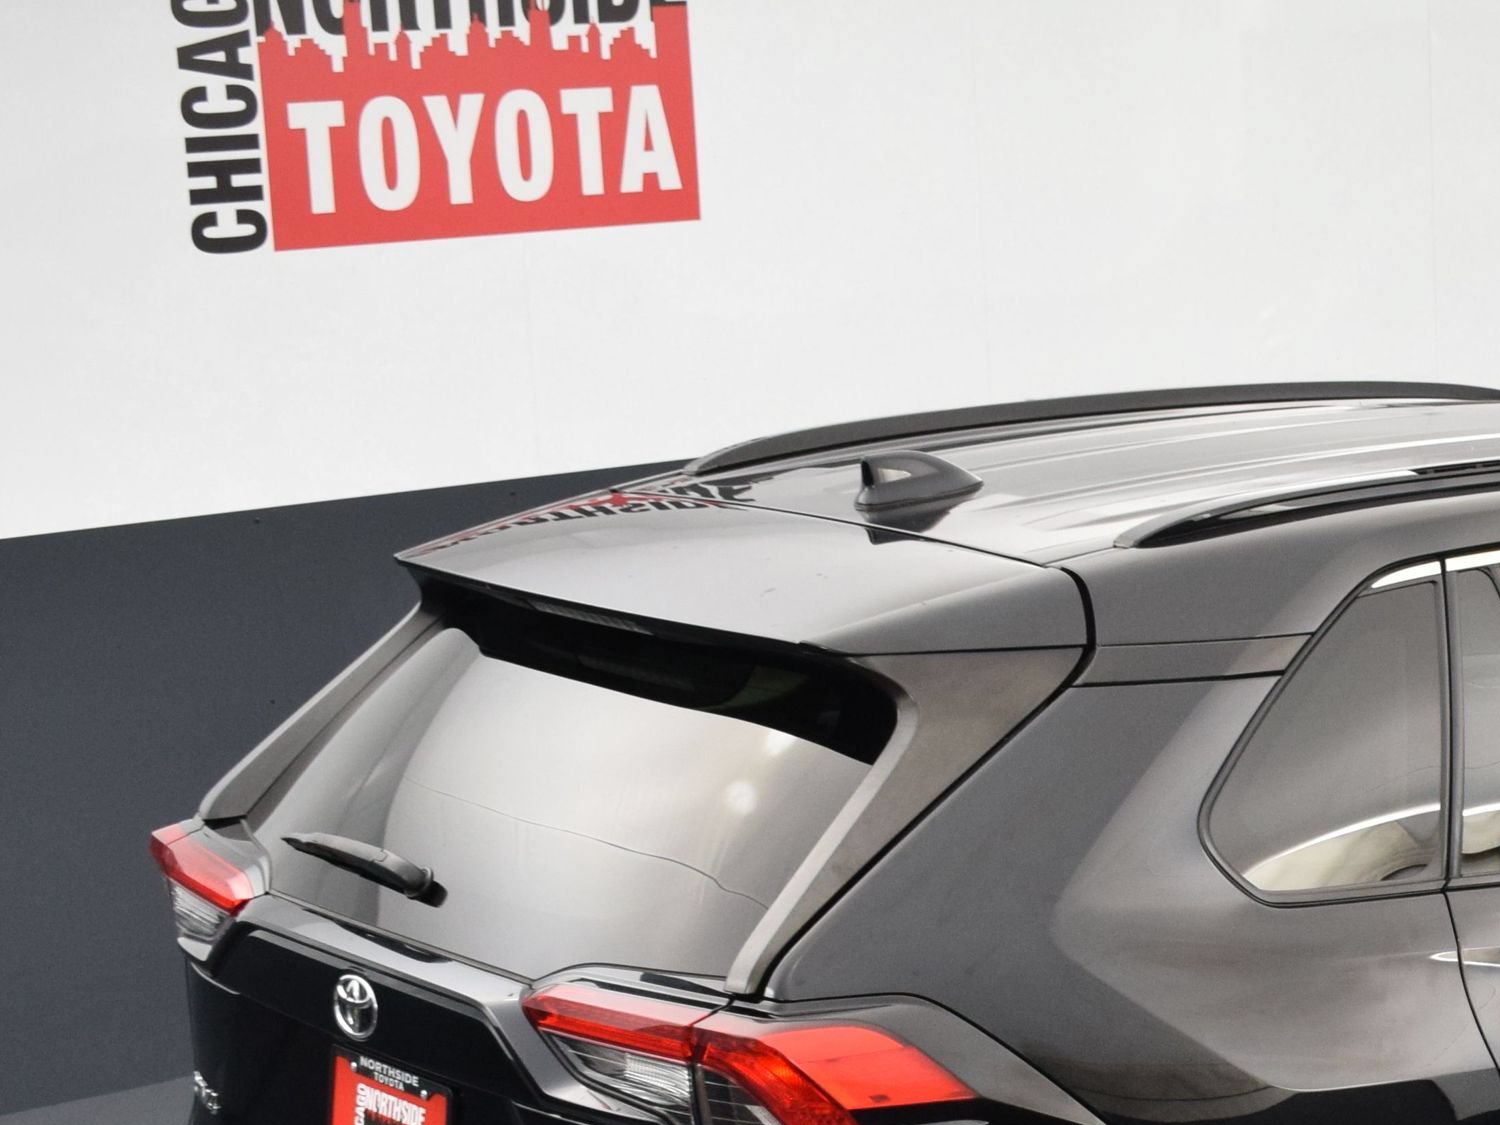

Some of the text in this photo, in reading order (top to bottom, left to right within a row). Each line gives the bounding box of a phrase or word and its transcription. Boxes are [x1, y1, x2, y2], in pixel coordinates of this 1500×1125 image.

[287, 85, 683, 214] TOYOTA
[360, 1056, 420, 1087] NORTHSIDE
[374, 1071, 405, 1092] TOYOTA
